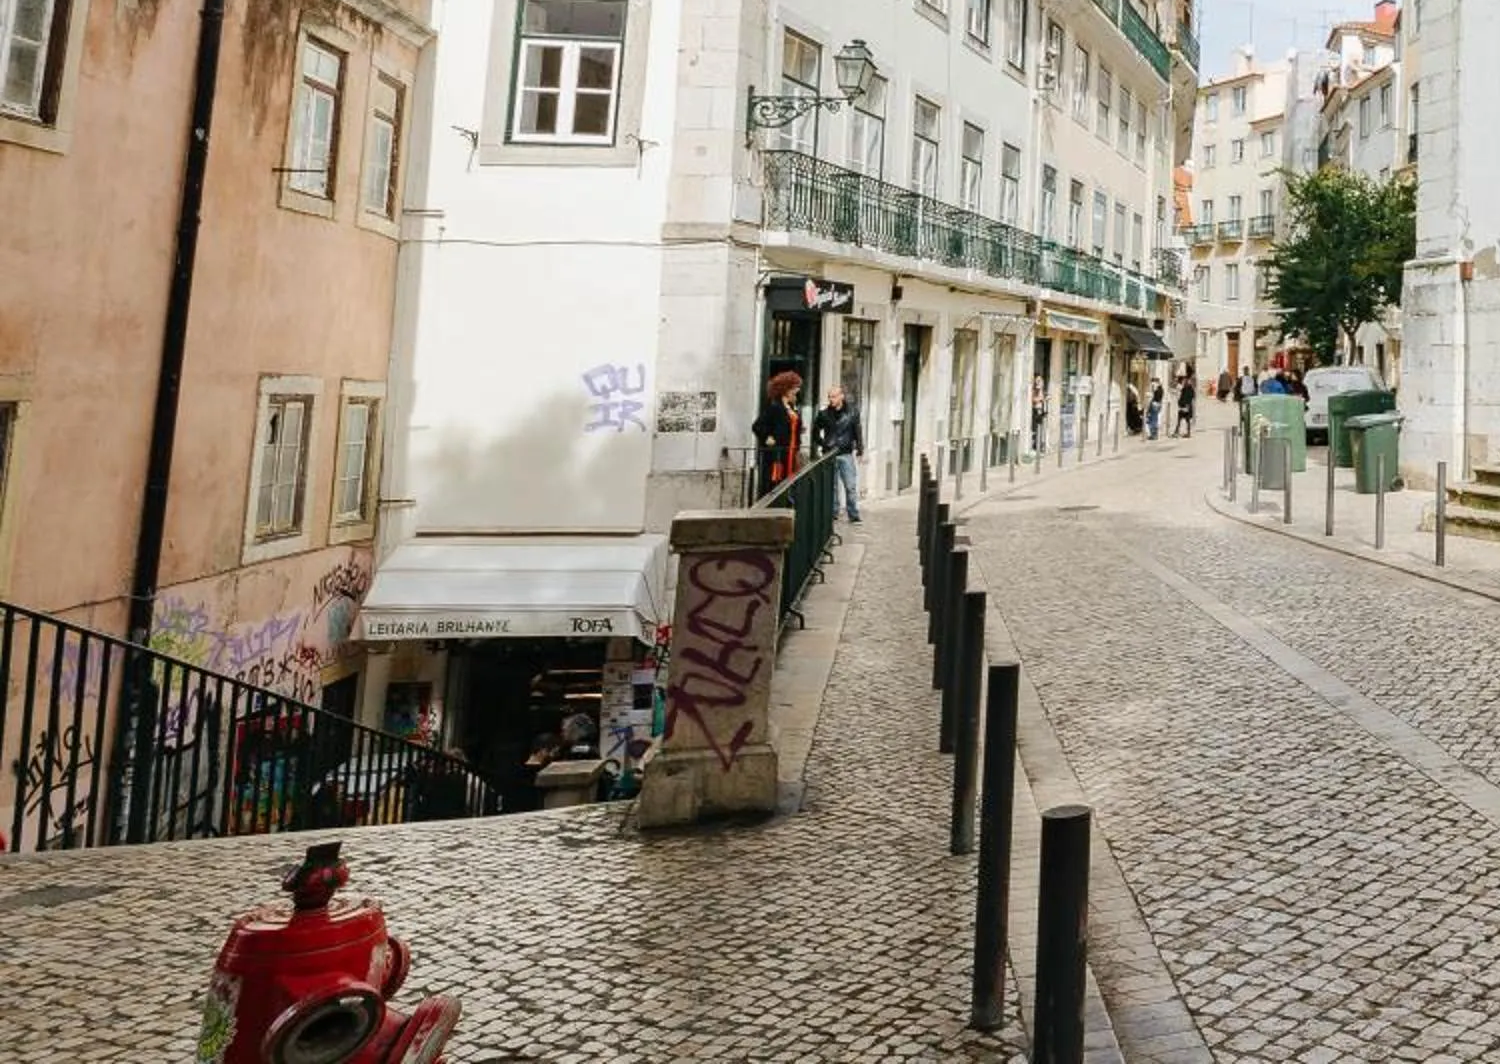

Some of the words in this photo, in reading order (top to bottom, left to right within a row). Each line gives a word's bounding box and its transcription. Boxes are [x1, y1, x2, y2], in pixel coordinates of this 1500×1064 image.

[368, 621, 430, 636] LEITARIA
[436, 620, 511, 634] BRILHANTE
[570, 618, 614, 633] TOFA
